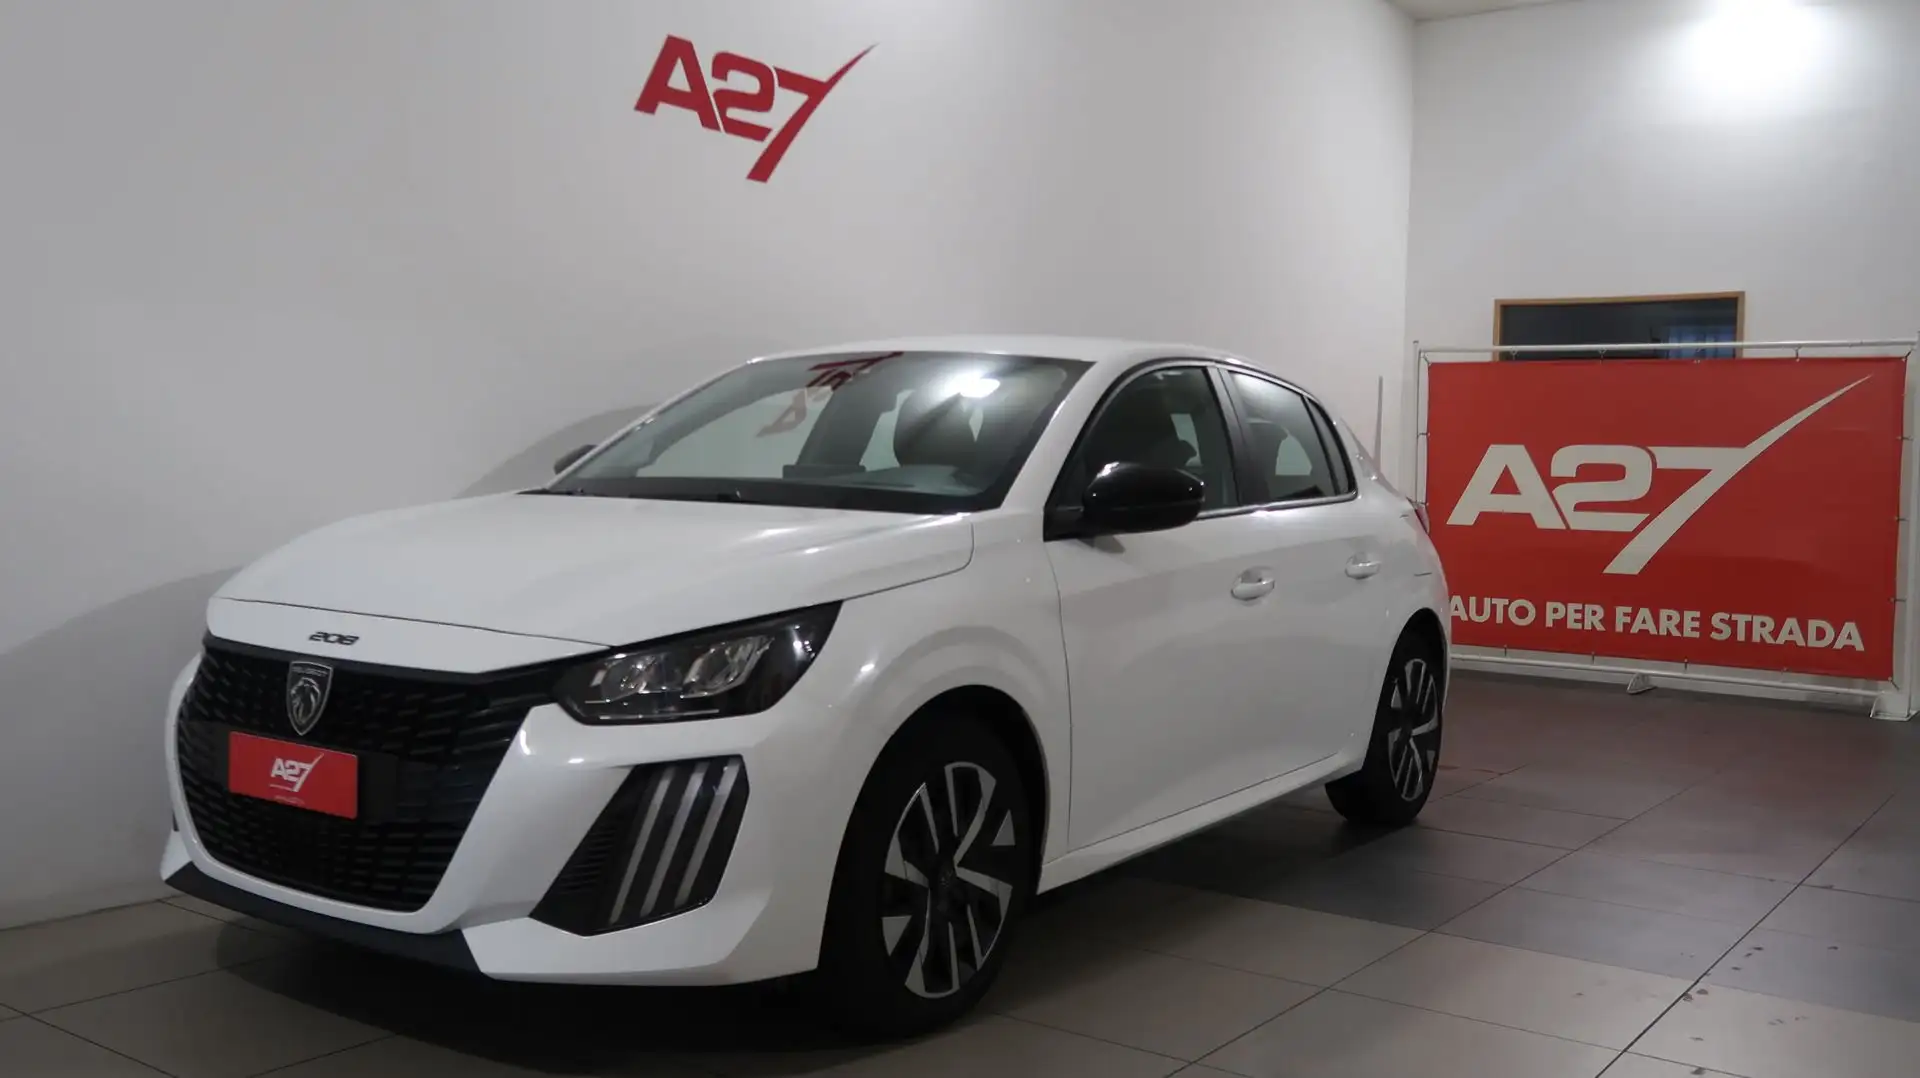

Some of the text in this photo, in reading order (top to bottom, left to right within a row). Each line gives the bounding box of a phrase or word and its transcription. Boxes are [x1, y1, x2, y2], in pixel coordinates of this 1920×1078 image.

[634, 34, 879, 183] A27
[1447, 376, 1871, 574] A27
[309, 631, 359, 646] 208
[1450, 595, 1865, 652] AUTO PER FARE STRADA
[270, 752, 325, 792] A27
